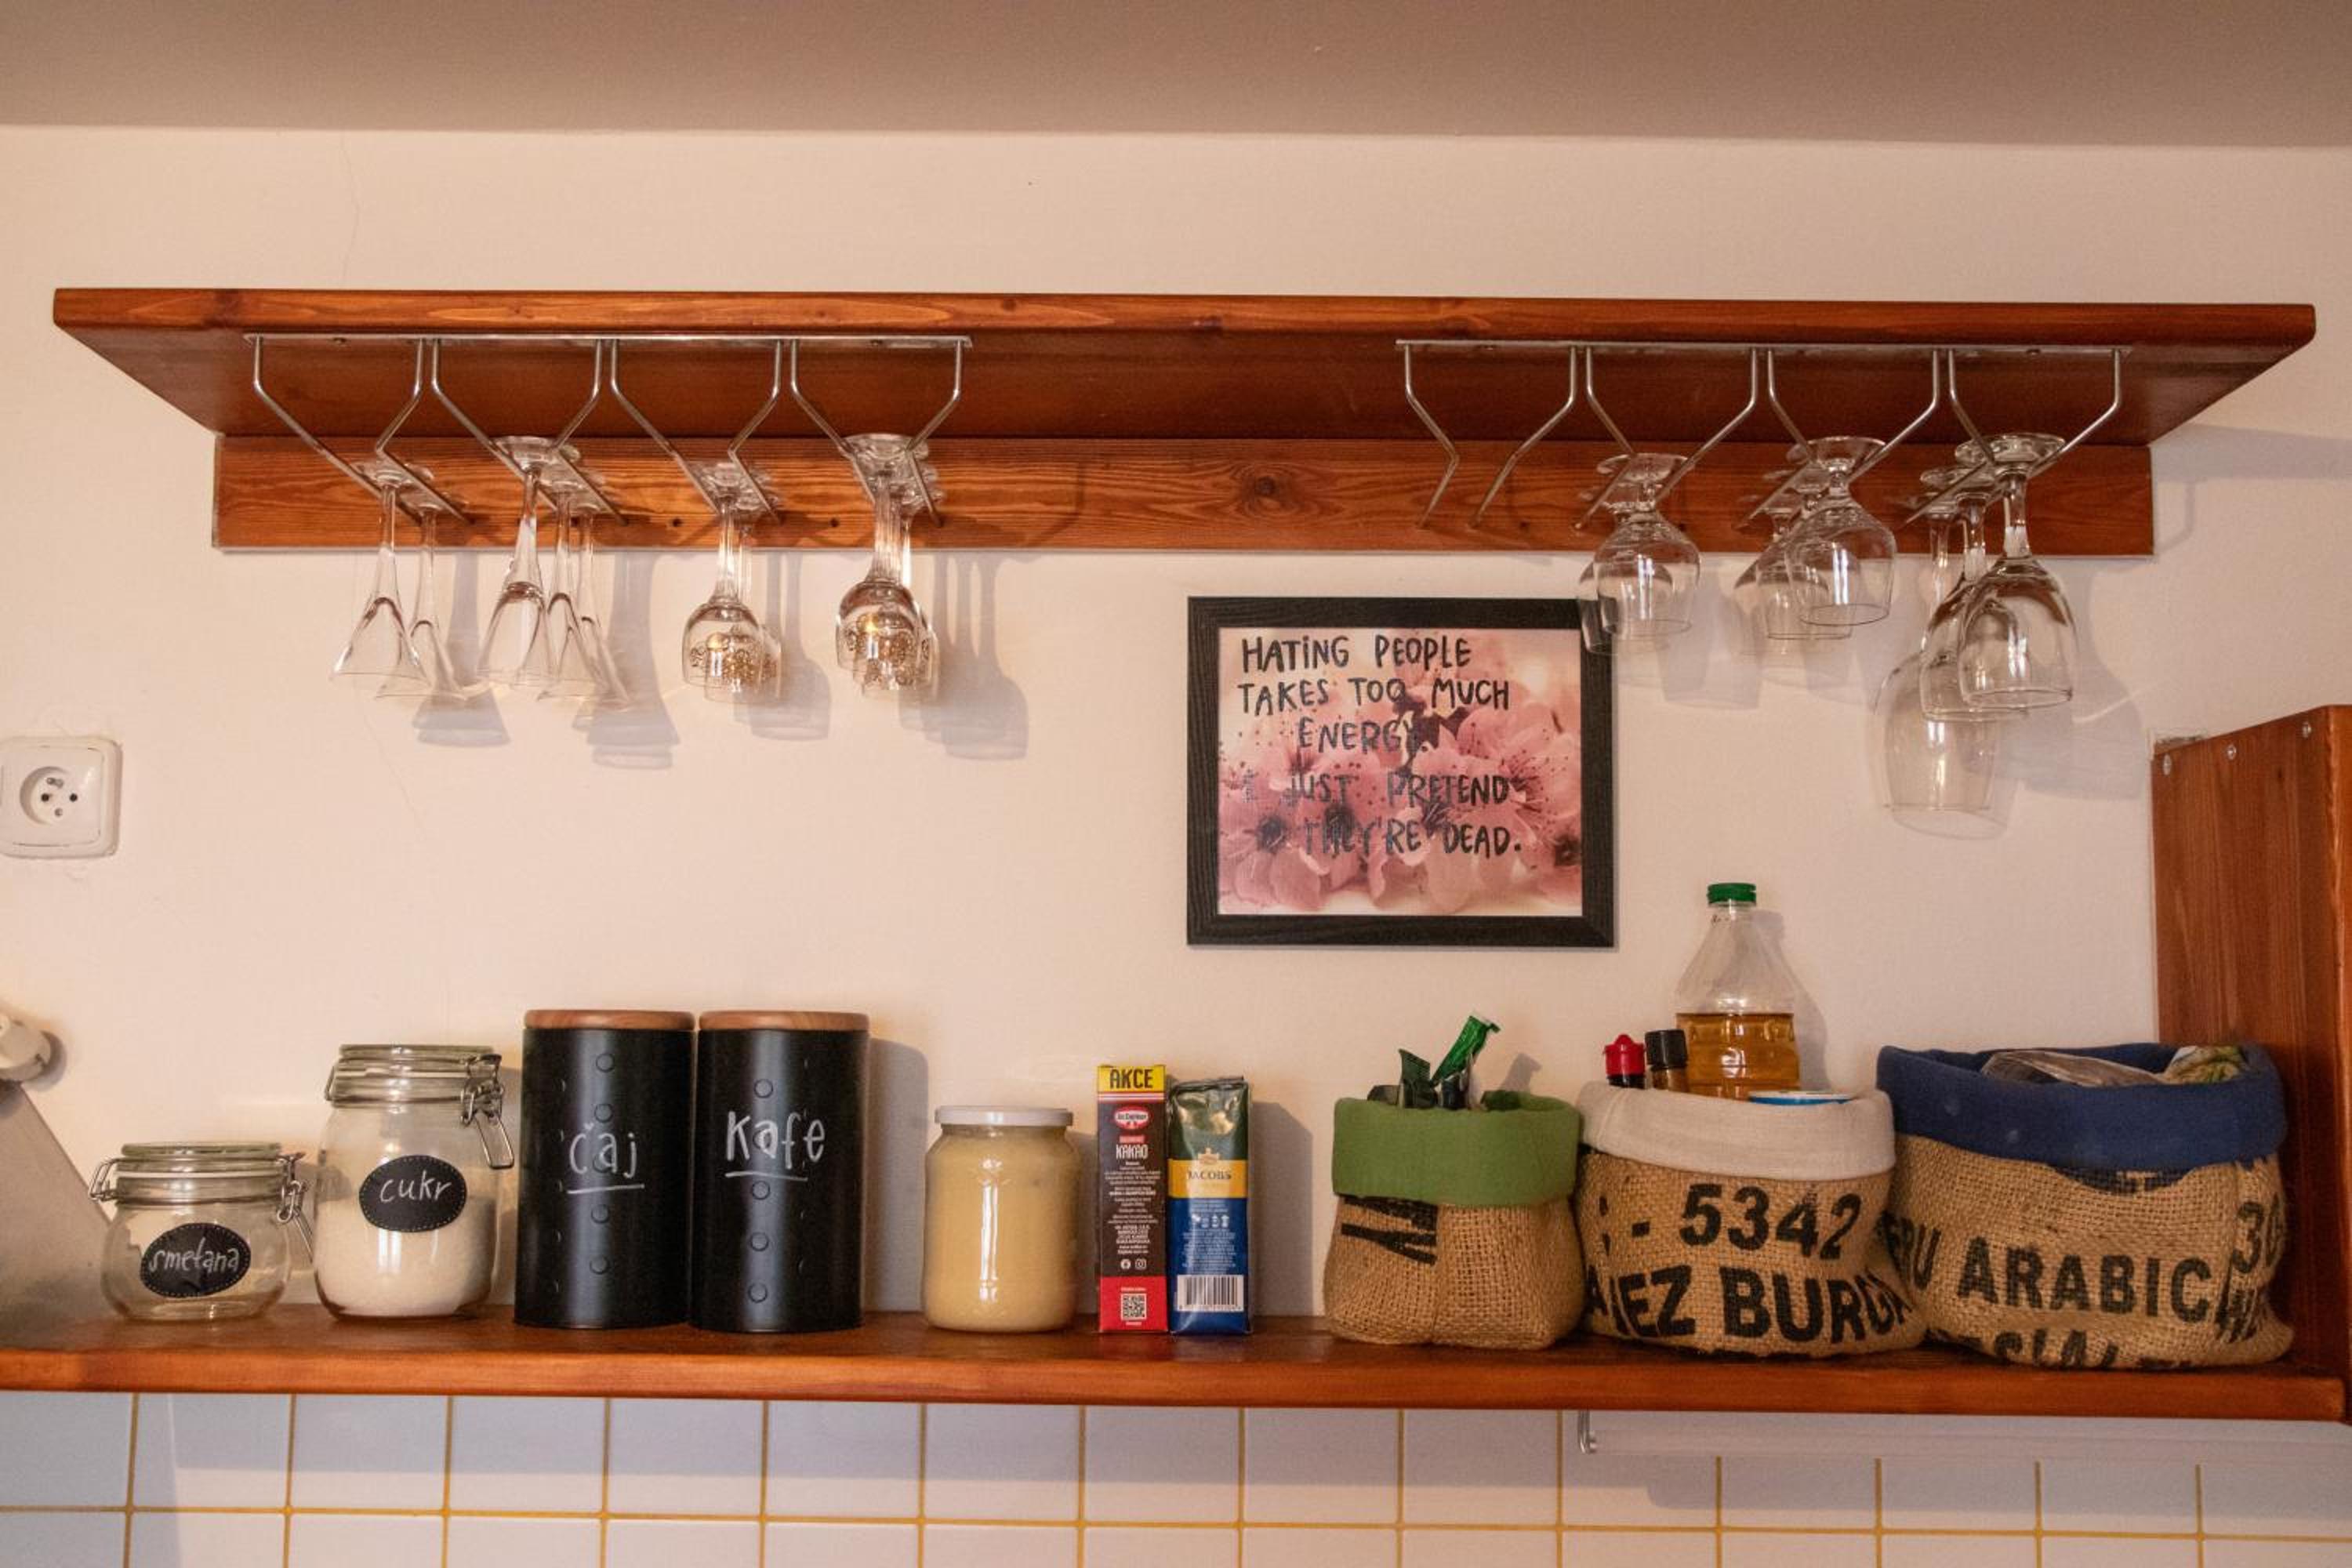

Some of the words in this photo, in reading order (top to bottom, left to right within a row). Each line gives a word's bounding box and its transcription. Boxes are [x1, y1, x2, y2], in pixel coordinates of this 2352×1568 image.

[1374, 635, 1472, 671] PEOPLE
[1237, 678, 1330, 717] TAKES
[1348, 677, 1407, 706] TOO
[1432, 679, 1509, 711] MUCH
[1386, 773, 1509, 808] PRETEND
[1443, 825, 1522, 858] DEAD.
[1109, 1069, 1153, 1089] AKCE
[726, 1111, 826, 1170] Kafe
[1116, 1144, 1149, 1160] KAKAO
[379, 1170, 452, 1204] cukr
[1679, 1184, 1862, 1260] 5342
[147, 1237, 241, 1273] smetana
